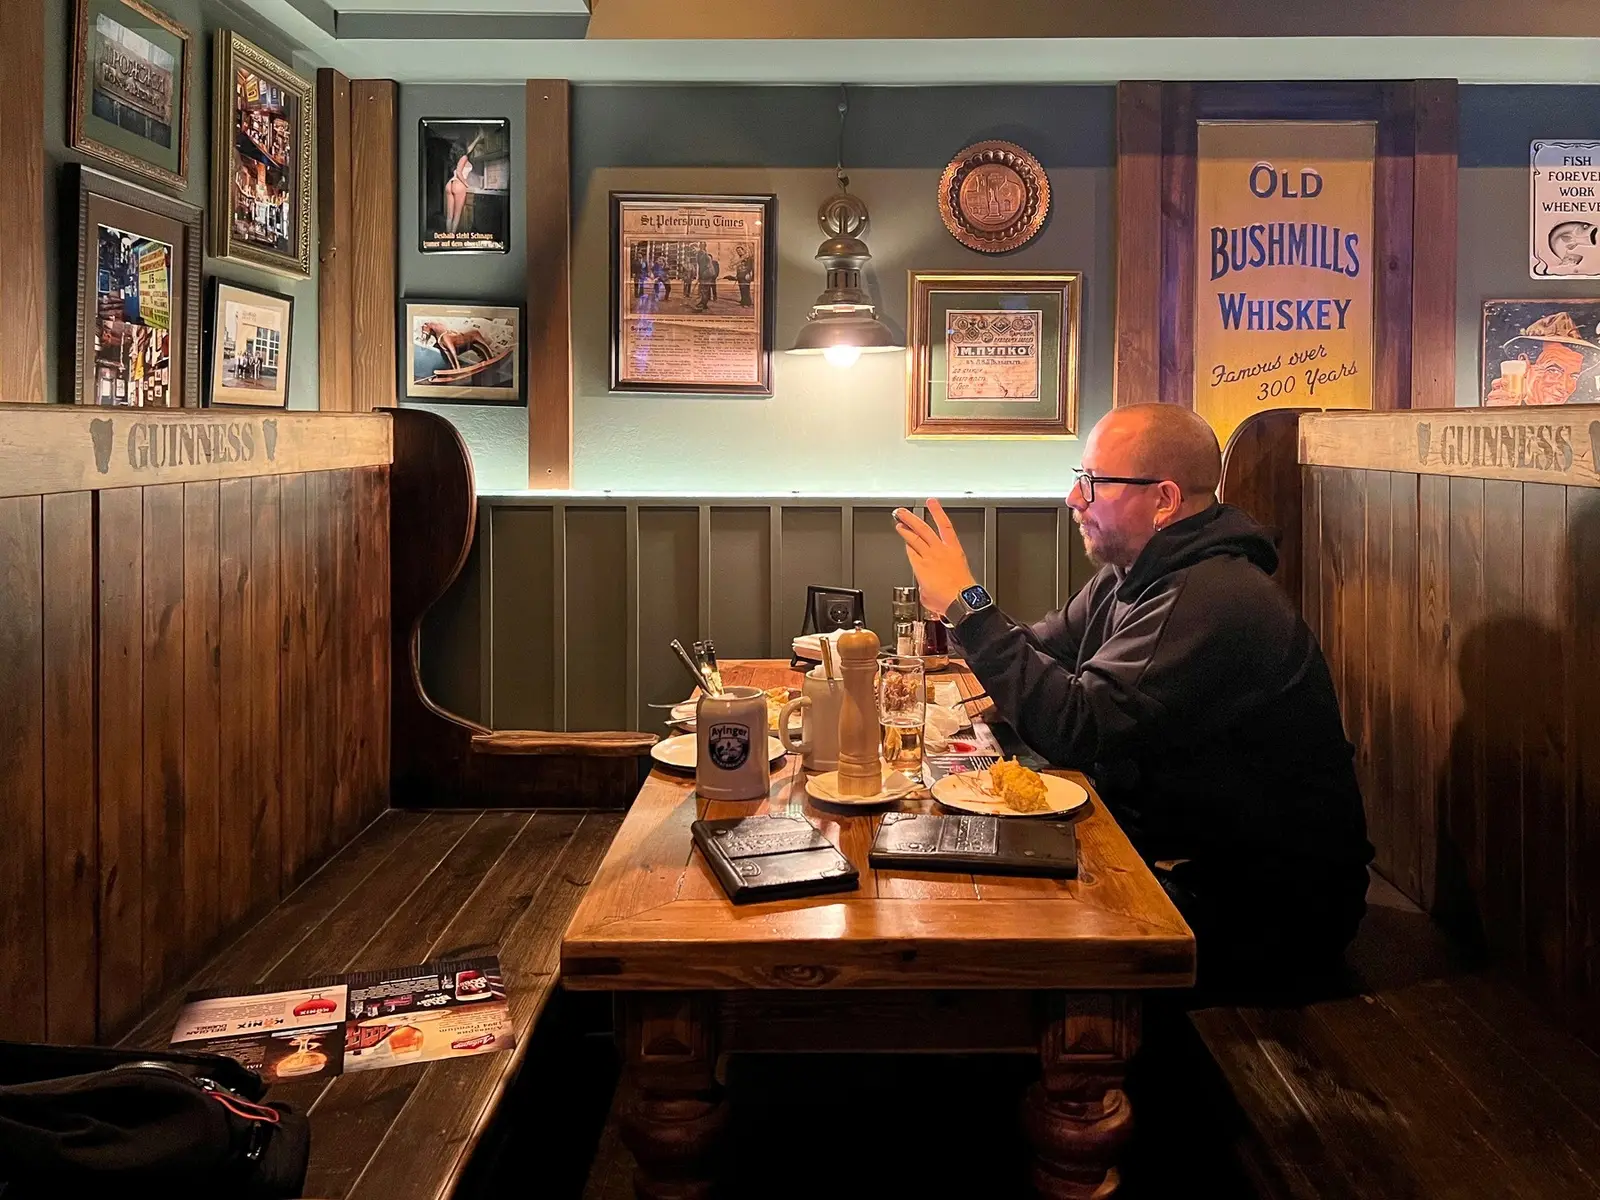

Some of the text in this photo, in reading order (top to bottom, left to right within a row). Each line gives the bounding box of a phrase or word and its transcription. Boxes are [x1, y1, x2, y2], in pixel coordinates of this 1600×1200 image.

[1249, 160, 1323, 199] OLD
[1548, 171, 1600, 181] FOREVE
[1563, 156, 1592, 167] FISH
[1559, 186, 1595, 197] WORK
[656, 214, 711, 228] Petersburg
[712, 215, 744, 228] Times
[1210, 222, 1360, 281] BUSHMILLS
[1217, 292, 1352, 332] WHISKEY
[1211, 344, 1328, 387] Famous over
[1257, 360, 1358, 401] 300 Years
[127, 422, 255, 470] GUINNESS
[1440, 425, 1573, 472] GUINNESS
[711, 726, 747, 738] Ayinger
